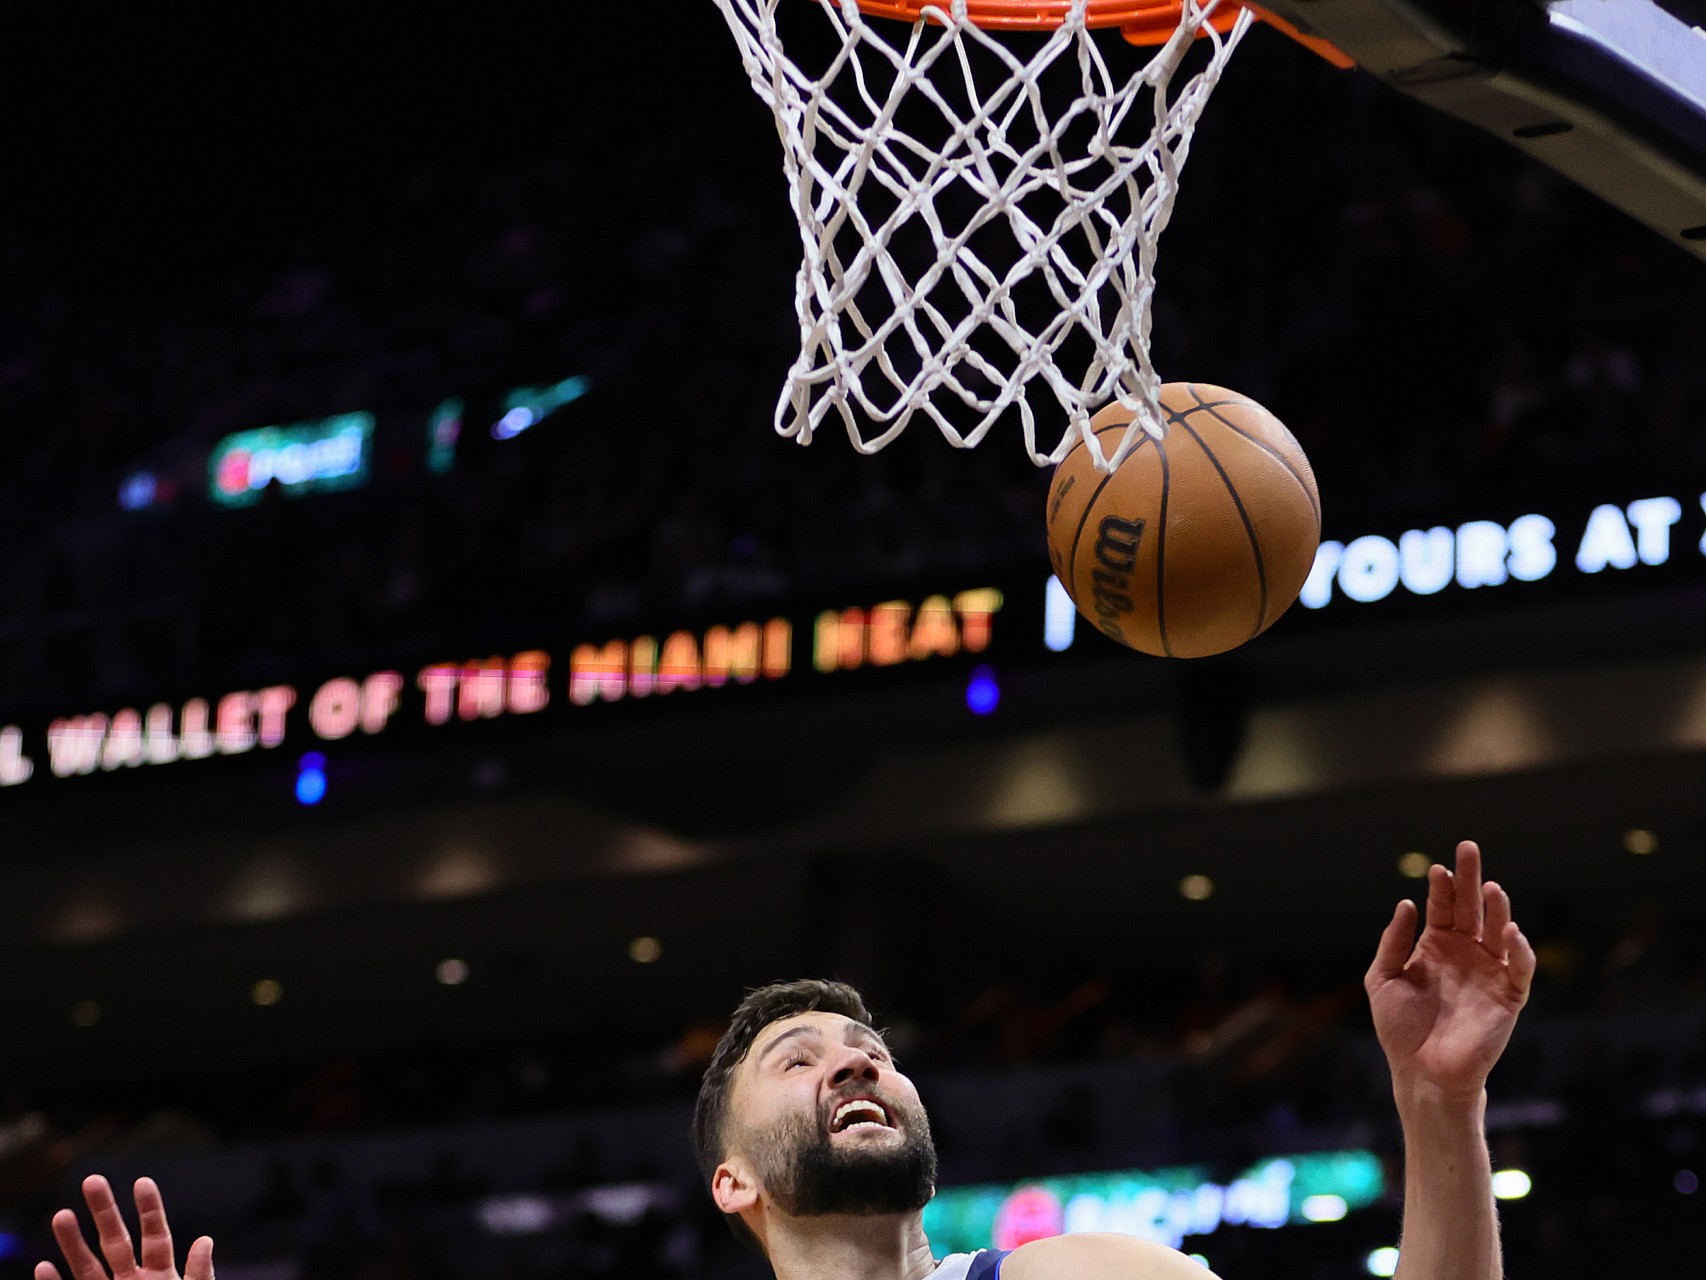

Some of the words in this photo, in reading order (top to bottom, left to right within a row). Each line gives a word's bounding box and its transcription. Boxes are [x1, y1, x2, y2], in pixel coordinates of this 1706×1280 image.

[1092, 514, 1146, 645] Wilso
[1300, 513, 1557, 609] YOURS
[1575, 496, 1683, 574] AT
[47, 685, 297, 778] WALLET
[309, 670, 403, 739] OF
[418, 650, 550, 723] THE
[569, 617, 793, 706] MIAMI
[813, 587, 1004, 673] HEAT
